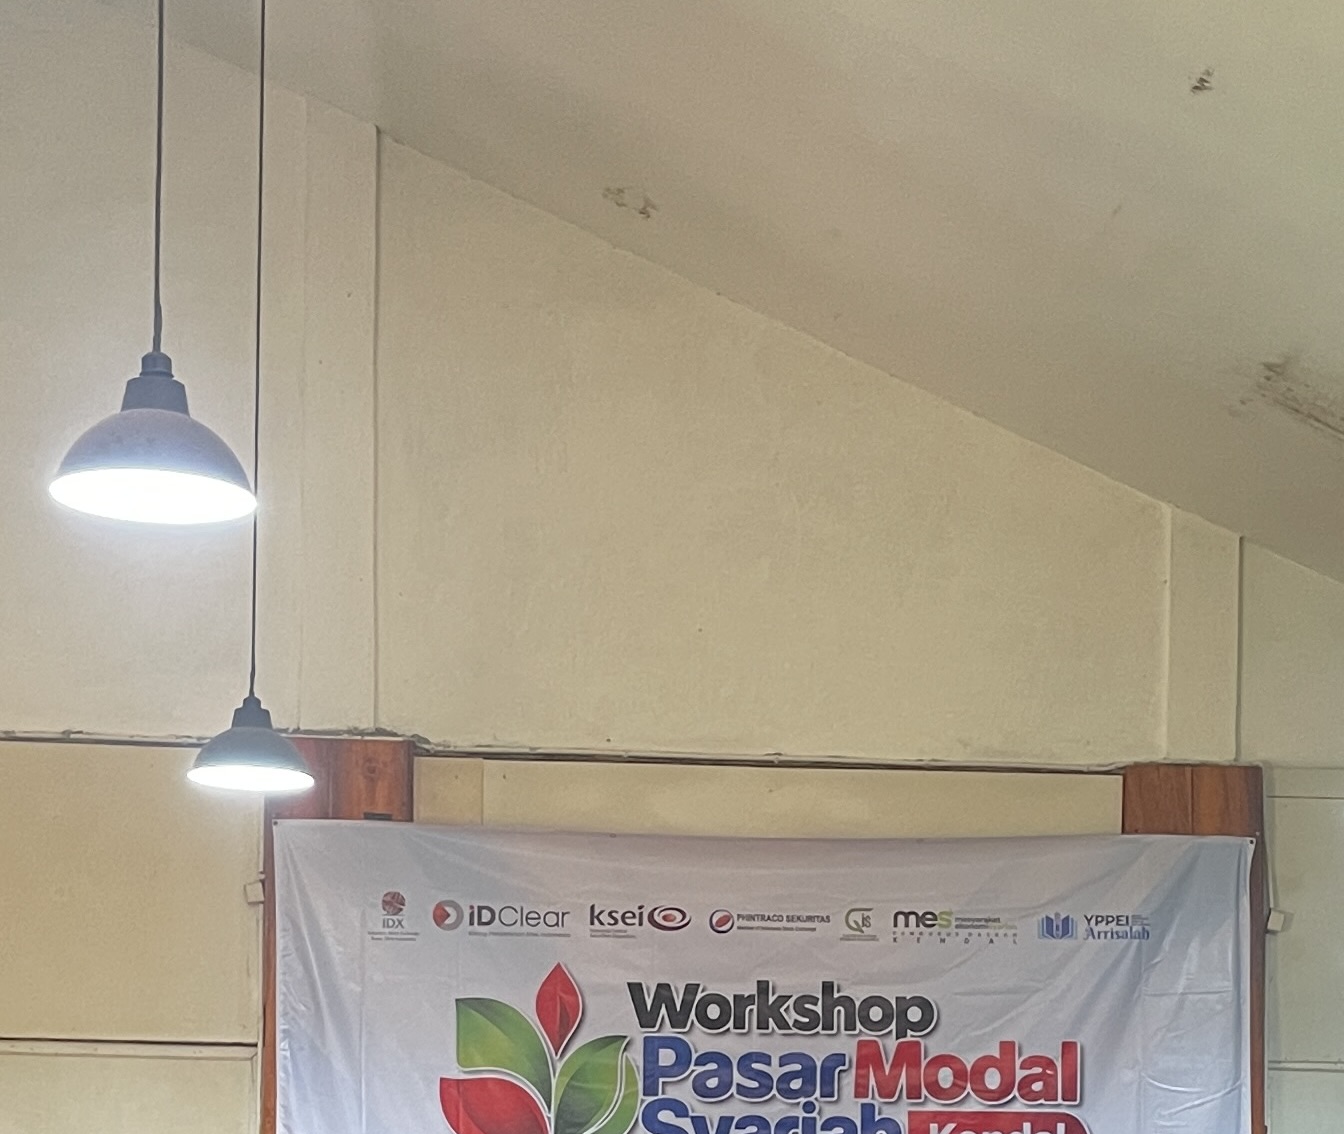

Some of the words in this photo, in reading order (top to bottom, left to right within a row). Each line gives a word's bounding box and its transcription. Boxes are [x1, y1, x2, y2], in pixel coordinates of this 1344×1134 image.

[382, 917, 405, 929] IDX
[468, 904, 570, 928] iDClear
[589, 904, 645, 927] ksei
[893, 909, 954, 928] mes
[1084, 914, 1130, 926] YPPEI
[627, 981, 937, 1040] Workshop
[642, 1037, 846, 1100] Pasar
[854, 1040, 1078, 1102] Modal
